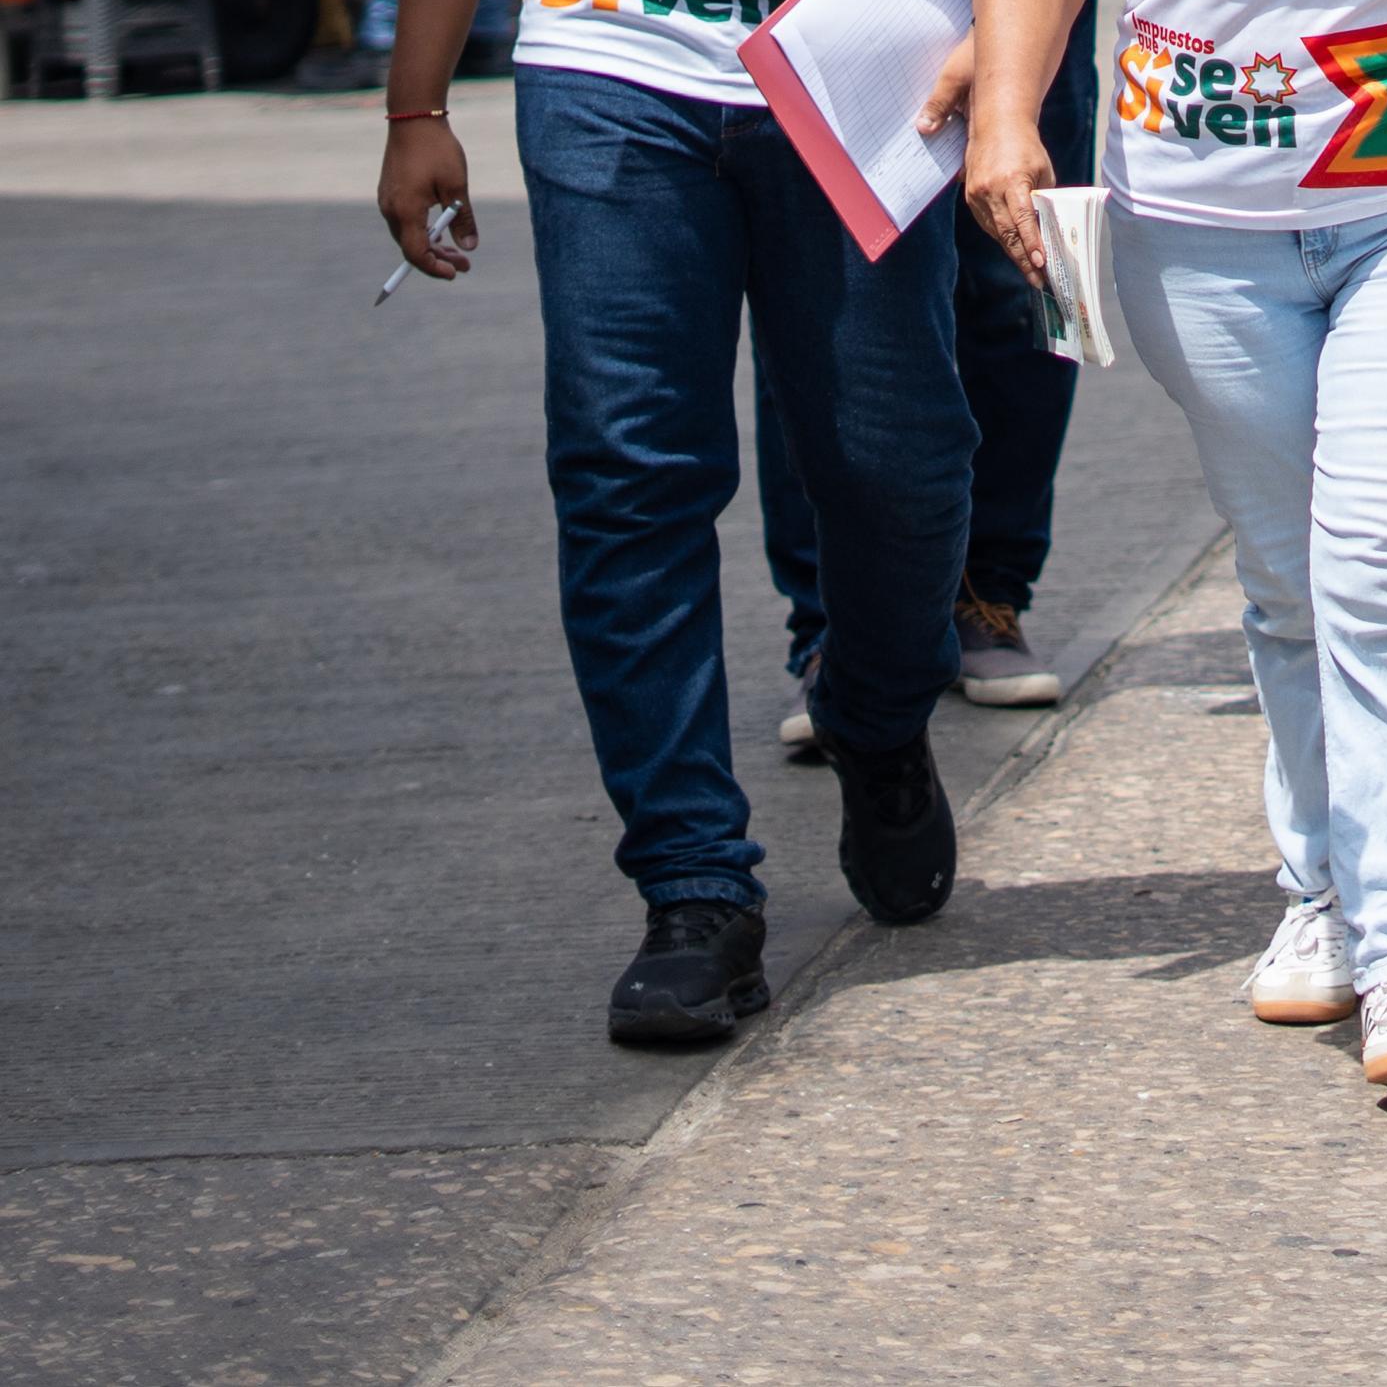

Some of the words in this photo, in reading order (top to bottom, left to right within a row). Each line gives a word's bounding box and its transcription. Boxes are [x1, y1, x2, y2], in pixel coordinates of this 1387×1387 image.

[1131, 12, 1215, 55] Impuestos
[1137, 32, 1160, 55] que
[1116, 43, 1173, 134] Sí
[1169, 52, 1237, 101] se
[1166, 98, 1297, 148] ven
